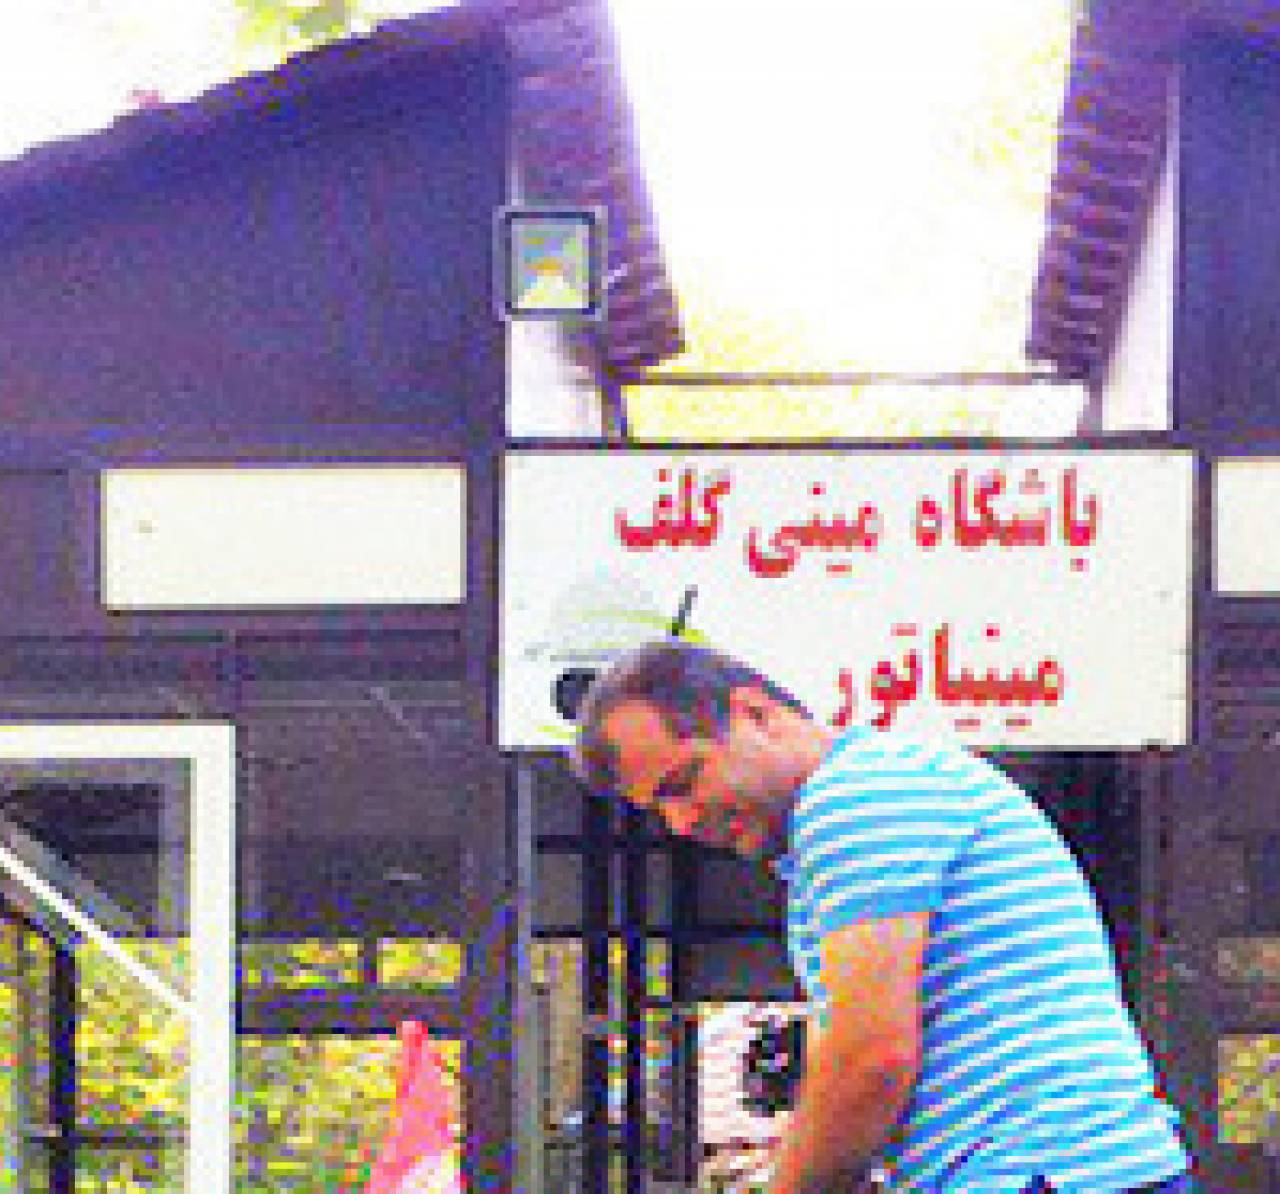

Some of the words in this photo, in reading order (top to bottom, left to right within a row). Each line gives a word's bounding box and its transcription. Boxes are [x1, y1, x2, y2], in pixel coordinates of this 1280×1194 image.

[615, 468, 730, 549] گلف
[744, 483, 880, 577] مینی
[914, 468, 1100, 571] باشگاه
[828, 624, 1064, 729] مینیاتور
